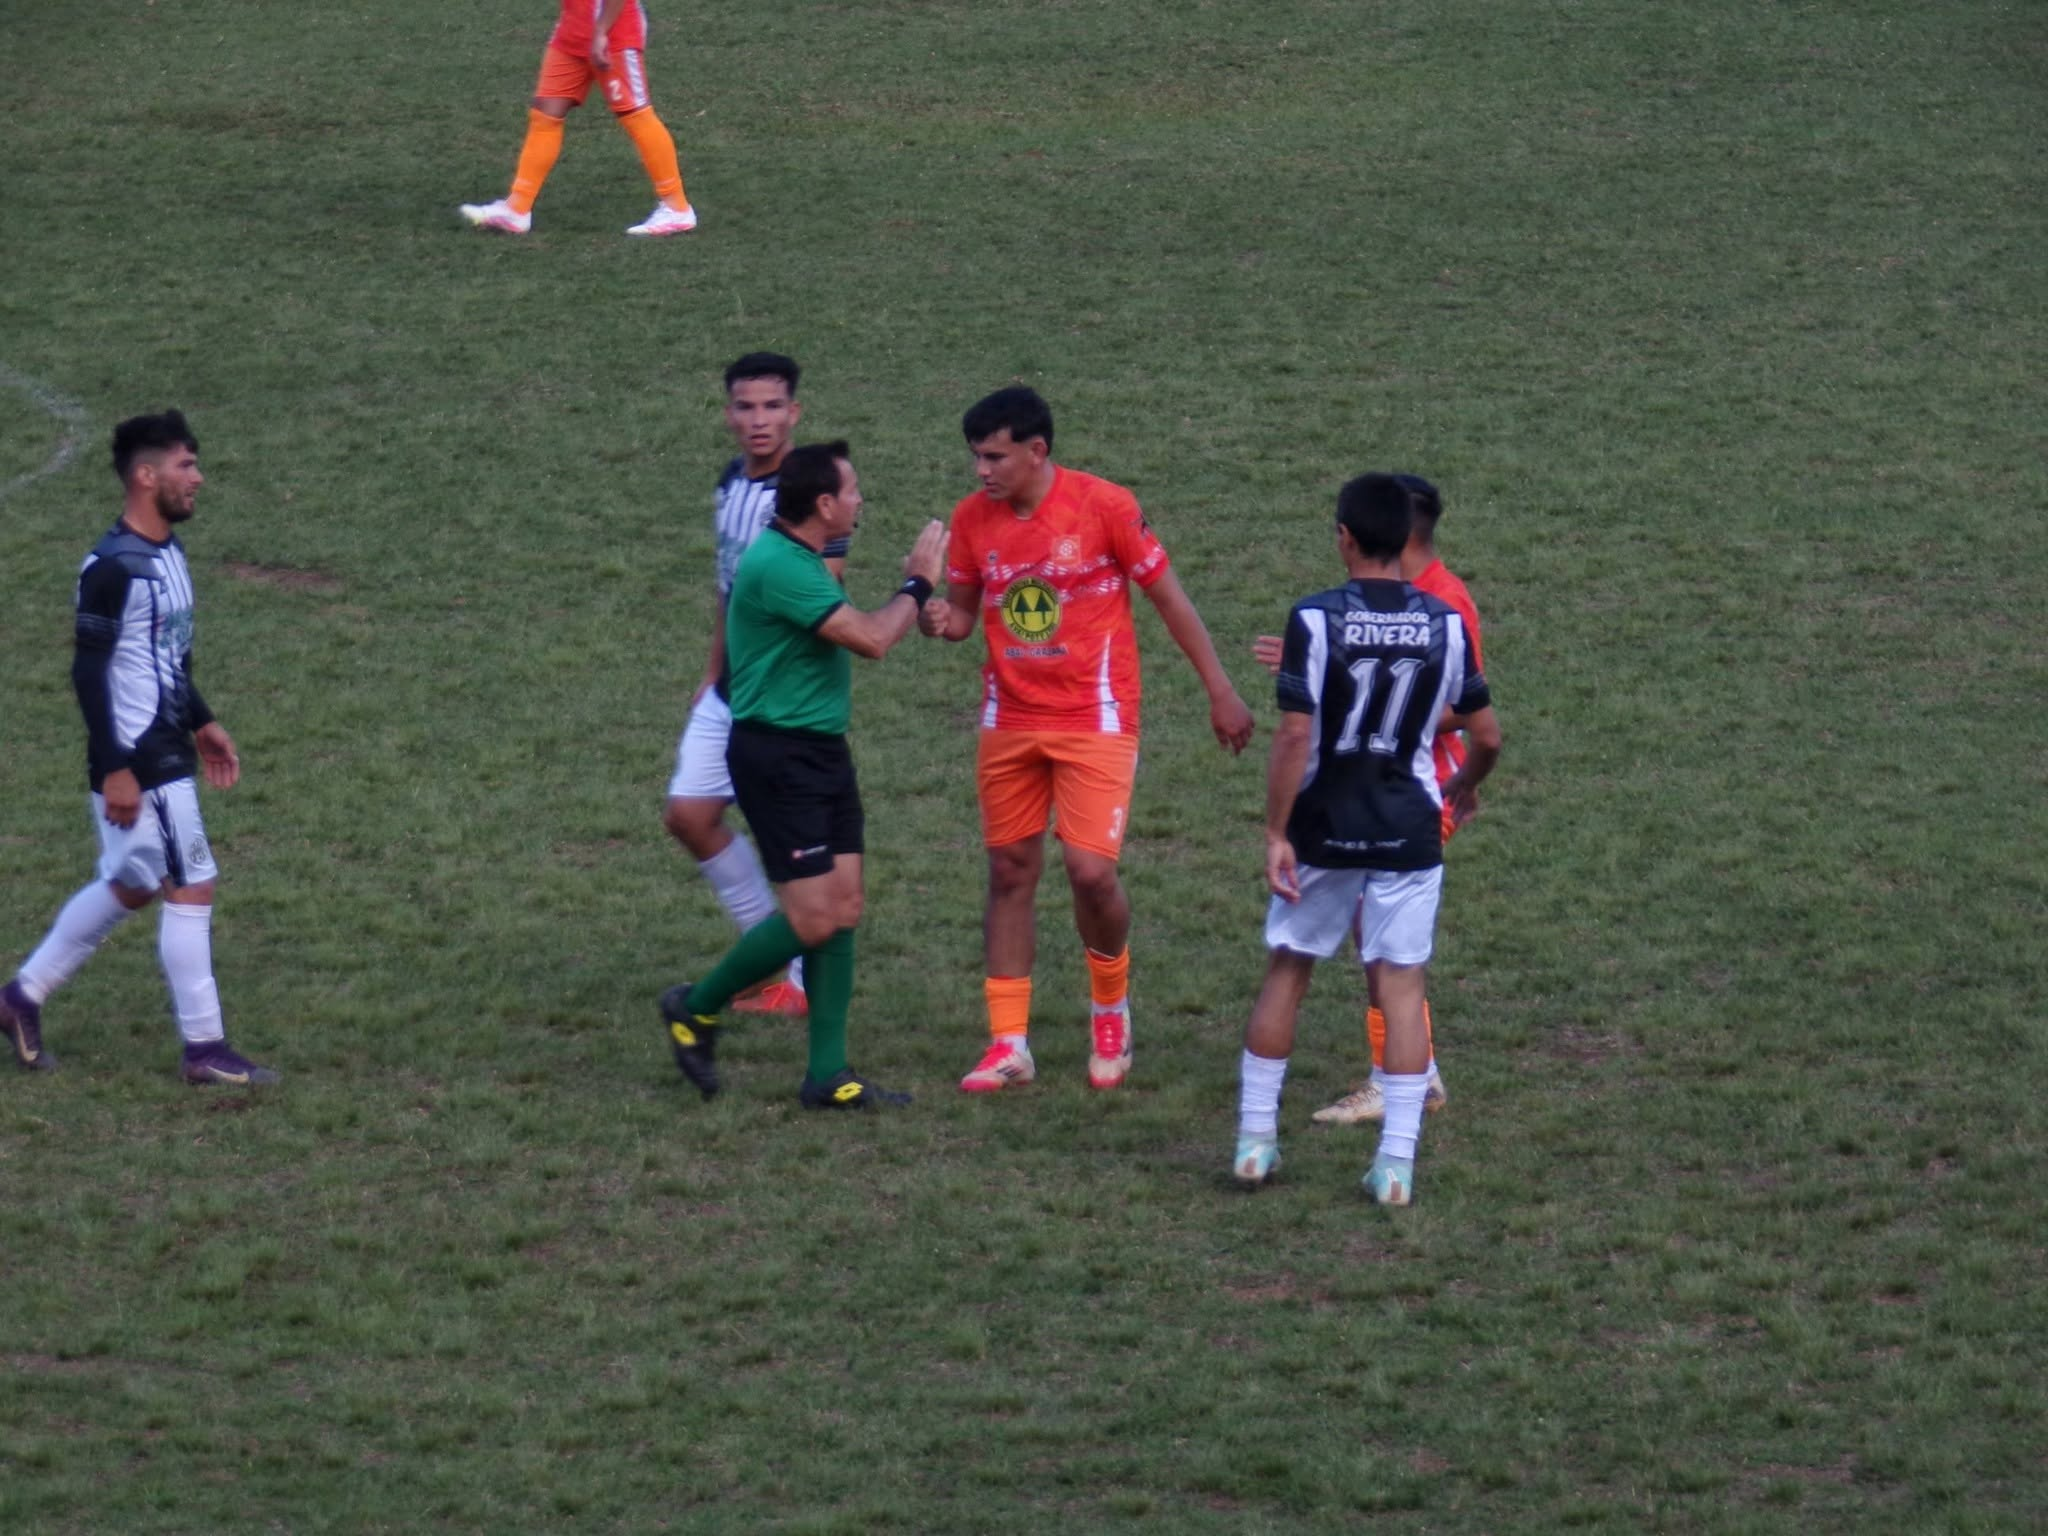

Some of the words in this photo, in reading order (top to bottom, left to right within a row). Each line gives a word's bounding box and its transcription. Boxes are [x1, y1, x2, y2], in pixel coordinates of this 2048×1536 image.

[608, 79, 623, 101] 2
[1345, 610, 1430, 624] GOBERNADOR
[1344, 624, 1430, 646] RIVERA
[1335, 657, 1426, 756] 11
[1109, 806, 1123, 839] 3
